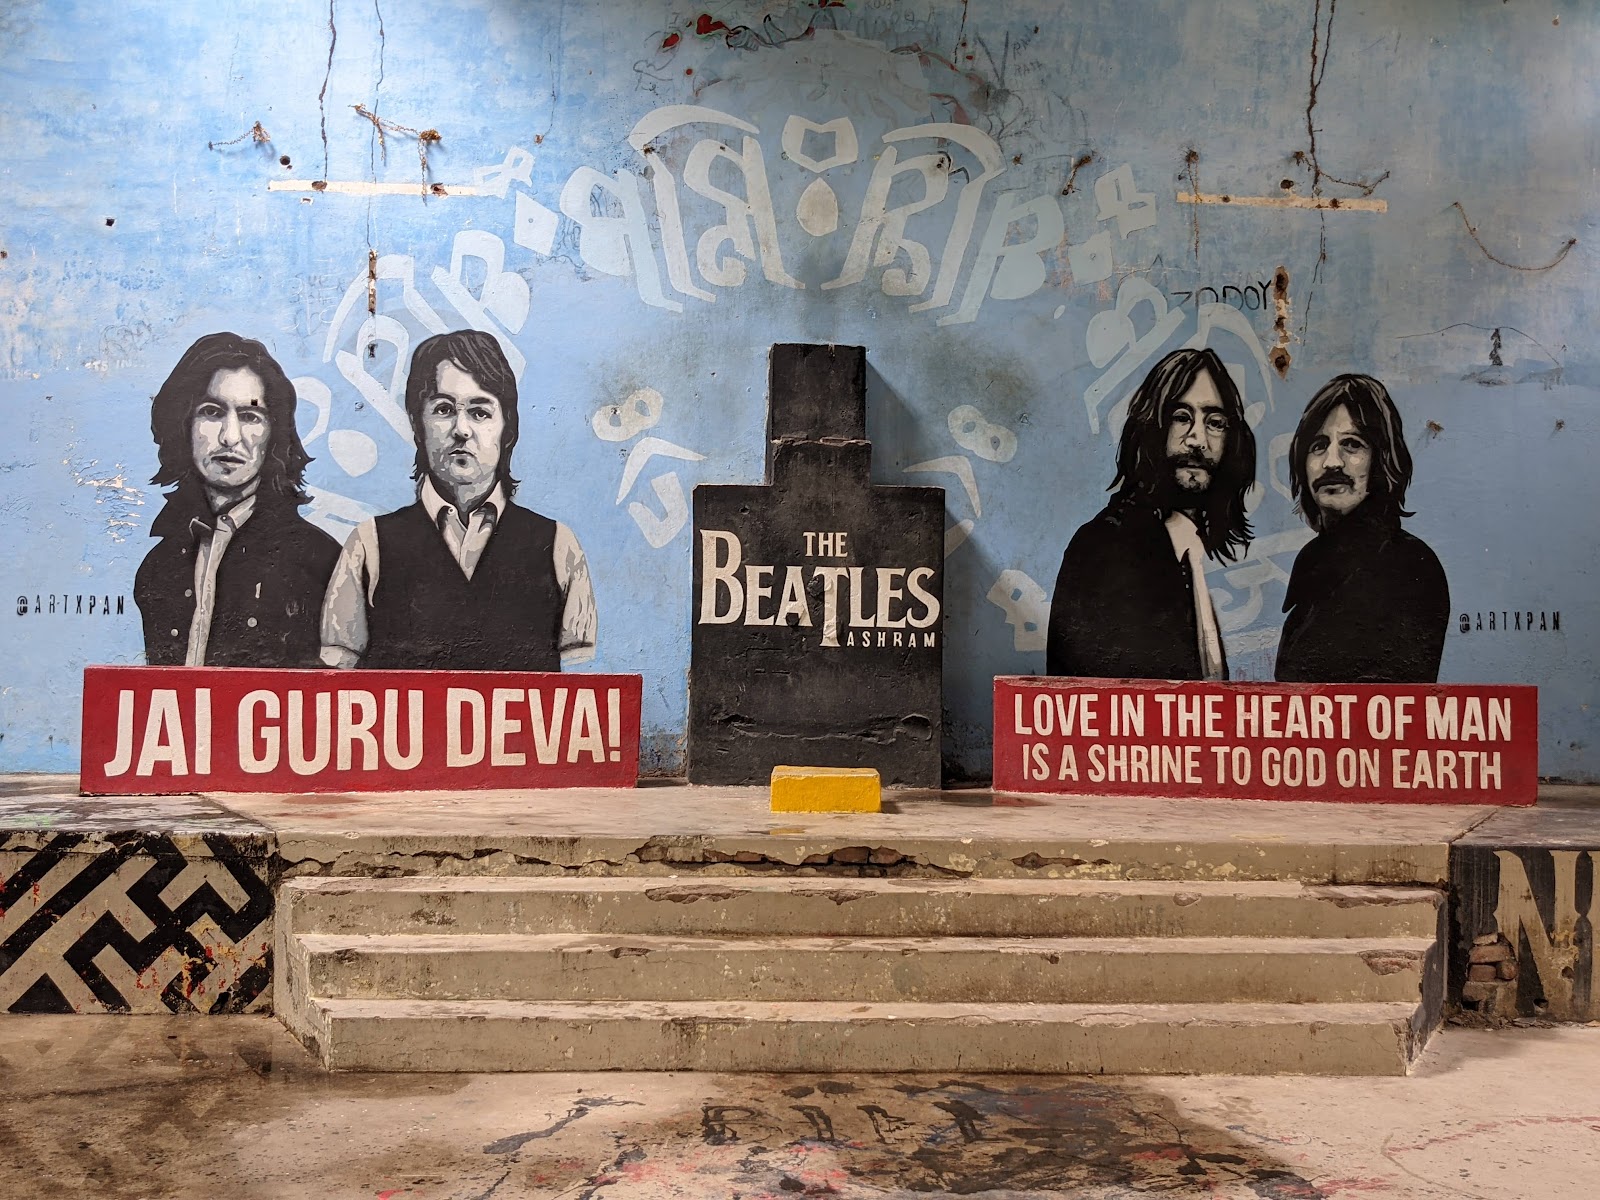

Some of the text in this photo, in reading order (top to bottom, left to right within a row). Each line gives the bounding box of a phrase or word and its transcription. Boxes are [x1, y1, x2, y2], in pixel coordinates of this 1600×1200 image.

[802, 532, 848, 558] THE
[16, 594, 124, 616] @ARTXPAN
[698, 528, 941, 648] BEATLES
[846, 630, 936, 648] ASHRAM
[1459, 611, 1561, 633] @ARTXPAN
[103, 687, 621, 777] JAI GURU DEVA!
[1014, 693, 1512, 742] LOVE IN THE HEART OF MAN
[1022, 742, 1502, 790] IS A SHRINE TO GOD ON EARTH
